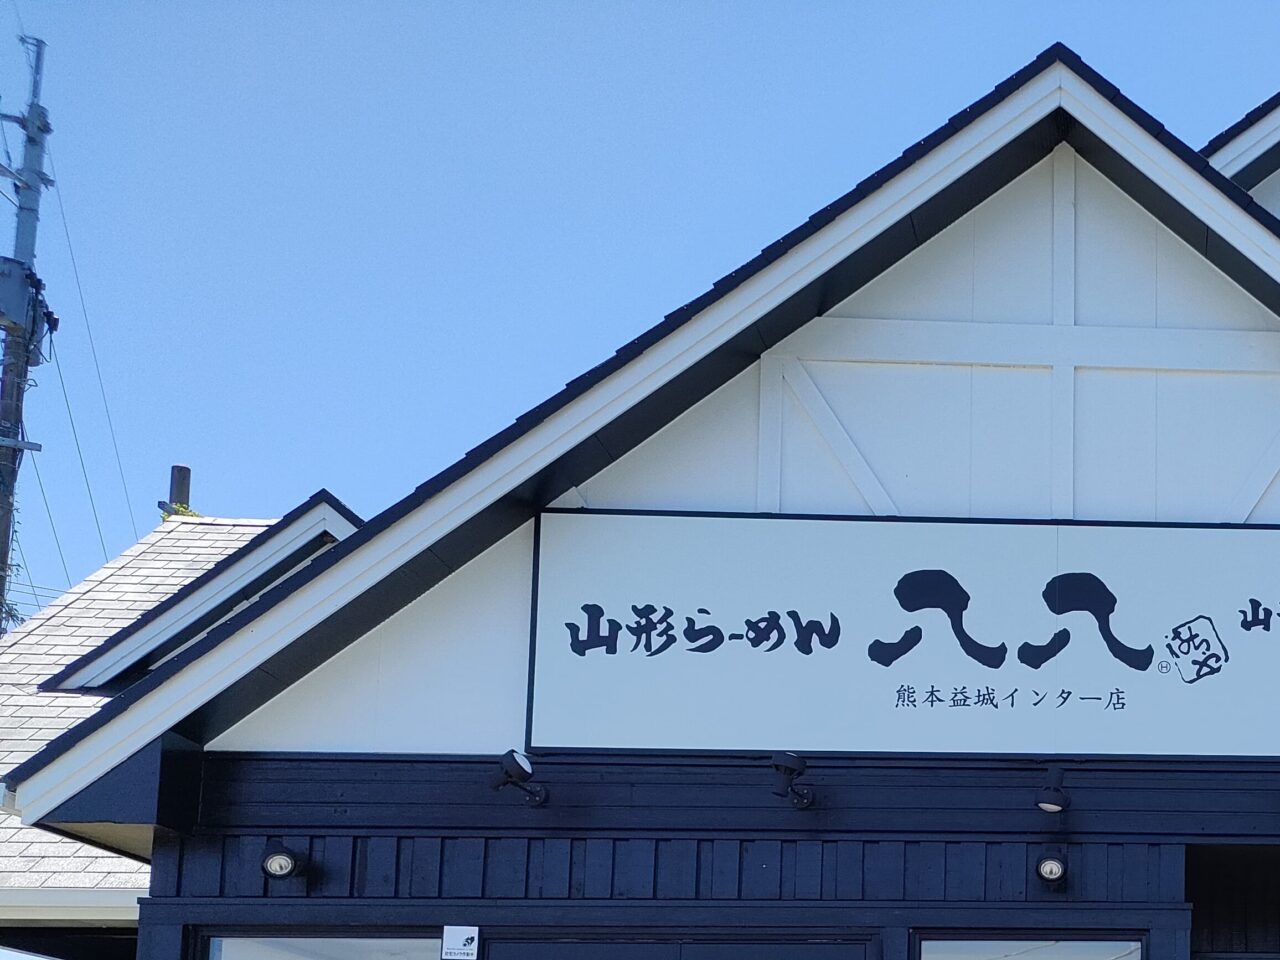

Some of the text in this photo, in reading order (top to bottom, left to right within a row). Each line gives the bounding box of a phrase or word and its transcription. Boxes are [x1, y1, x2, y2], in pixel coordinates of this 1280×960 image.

[565, 604, 840, 656] 山形らーめん
[868, 570, 1154, 671] 八八
[896, 685, 1126, 710] 熊本益城インター店
